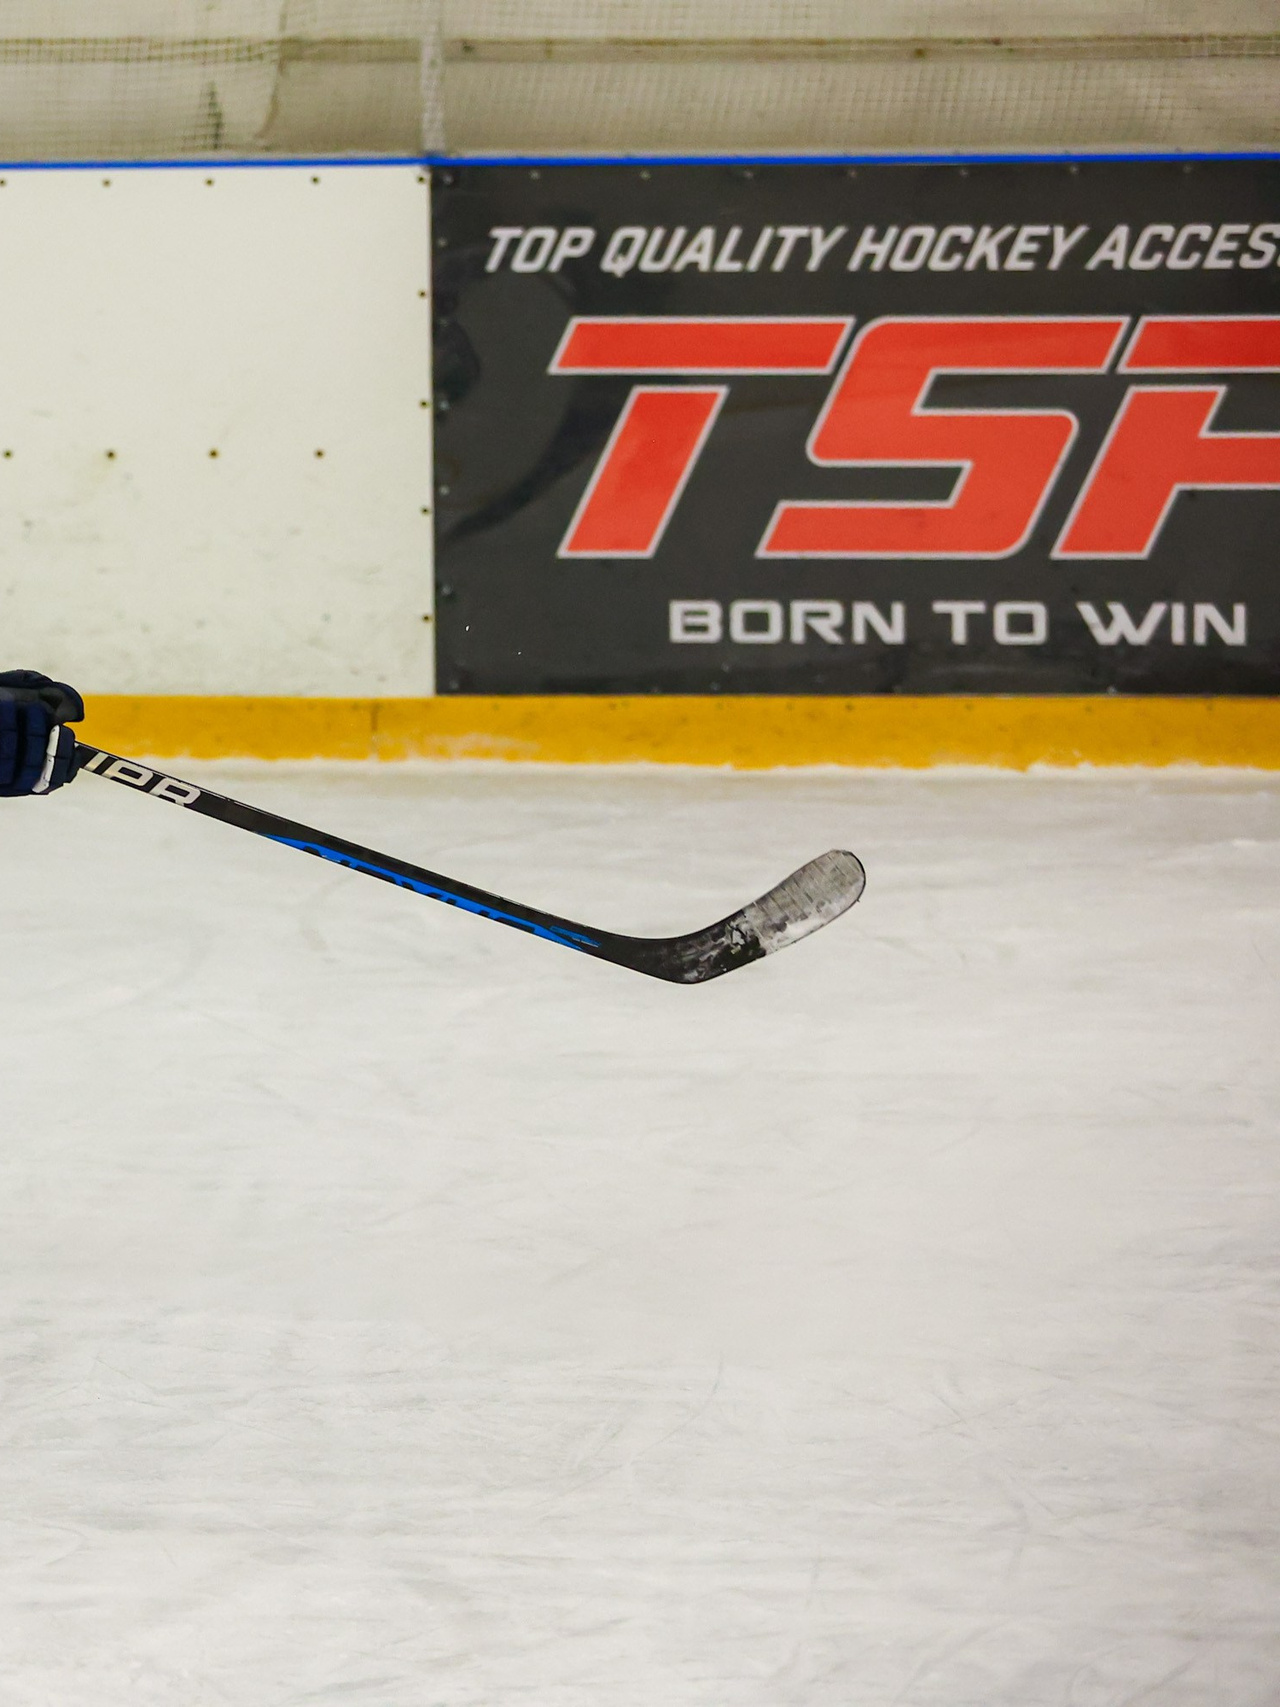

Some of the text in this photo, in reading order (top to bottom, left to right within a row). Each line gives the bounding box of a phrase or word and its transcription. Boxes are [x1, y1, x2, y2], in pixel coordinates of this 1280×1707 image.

[486, 223, 1280, 276] TOP QUALITY HOCKEY ACCES
[669, 601, 1246, 646] BORN TO WIN
